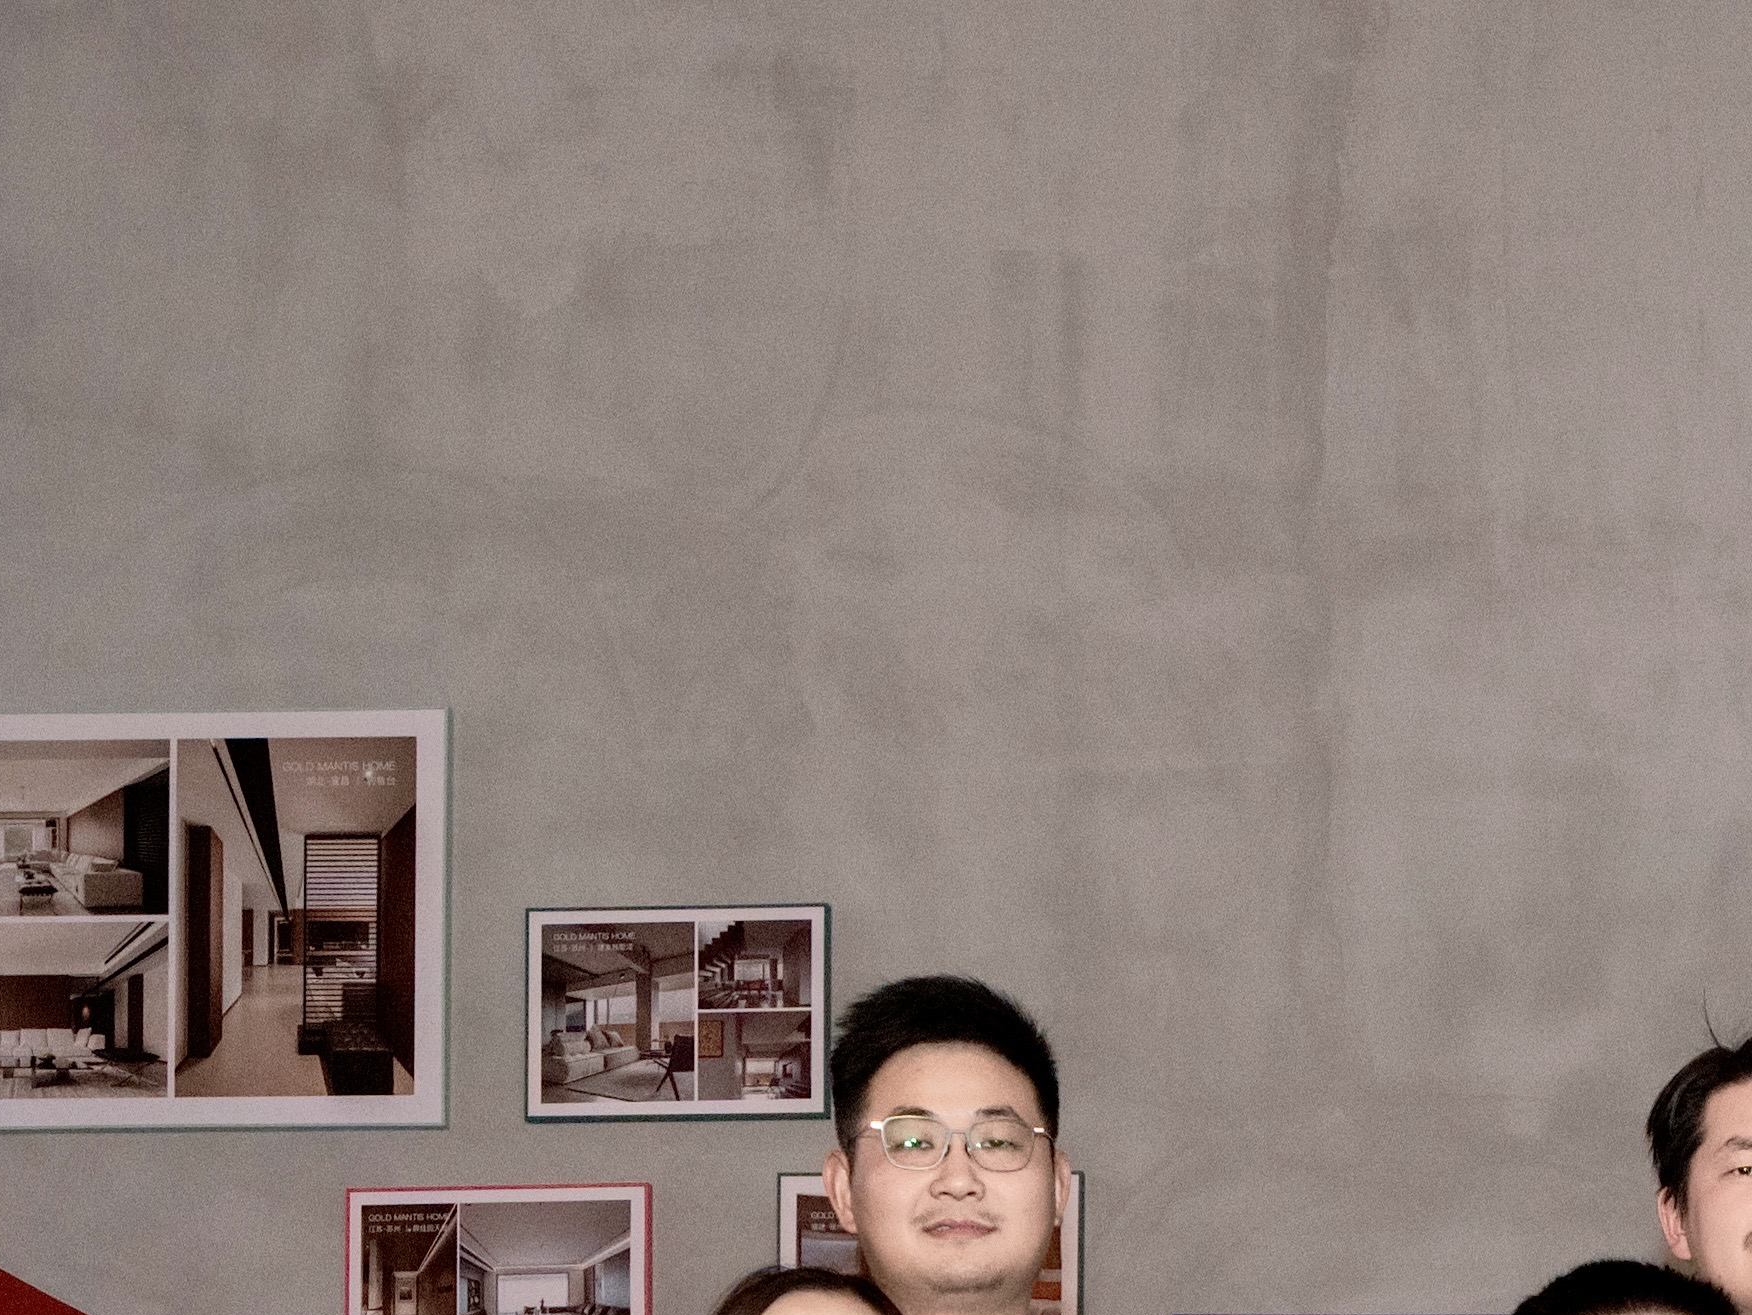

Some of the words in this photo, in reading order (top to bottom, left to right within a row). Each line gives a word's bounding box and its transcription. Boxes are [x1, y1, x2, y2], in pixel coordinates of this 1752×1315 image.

[282, 761, 314, 772] GOLD
[316, 760, 360, 771] MANTIS
[552, 932, 578, 941] GOLD
[578, 932, 609, 941] MANTIS
[611, 931, 635, 941] HOME
[367, 1213, 393, 1223] GOLD
[393, 1212, 425, 1222] MANTIS
[810, 1211, 835, 1220] GOLD
